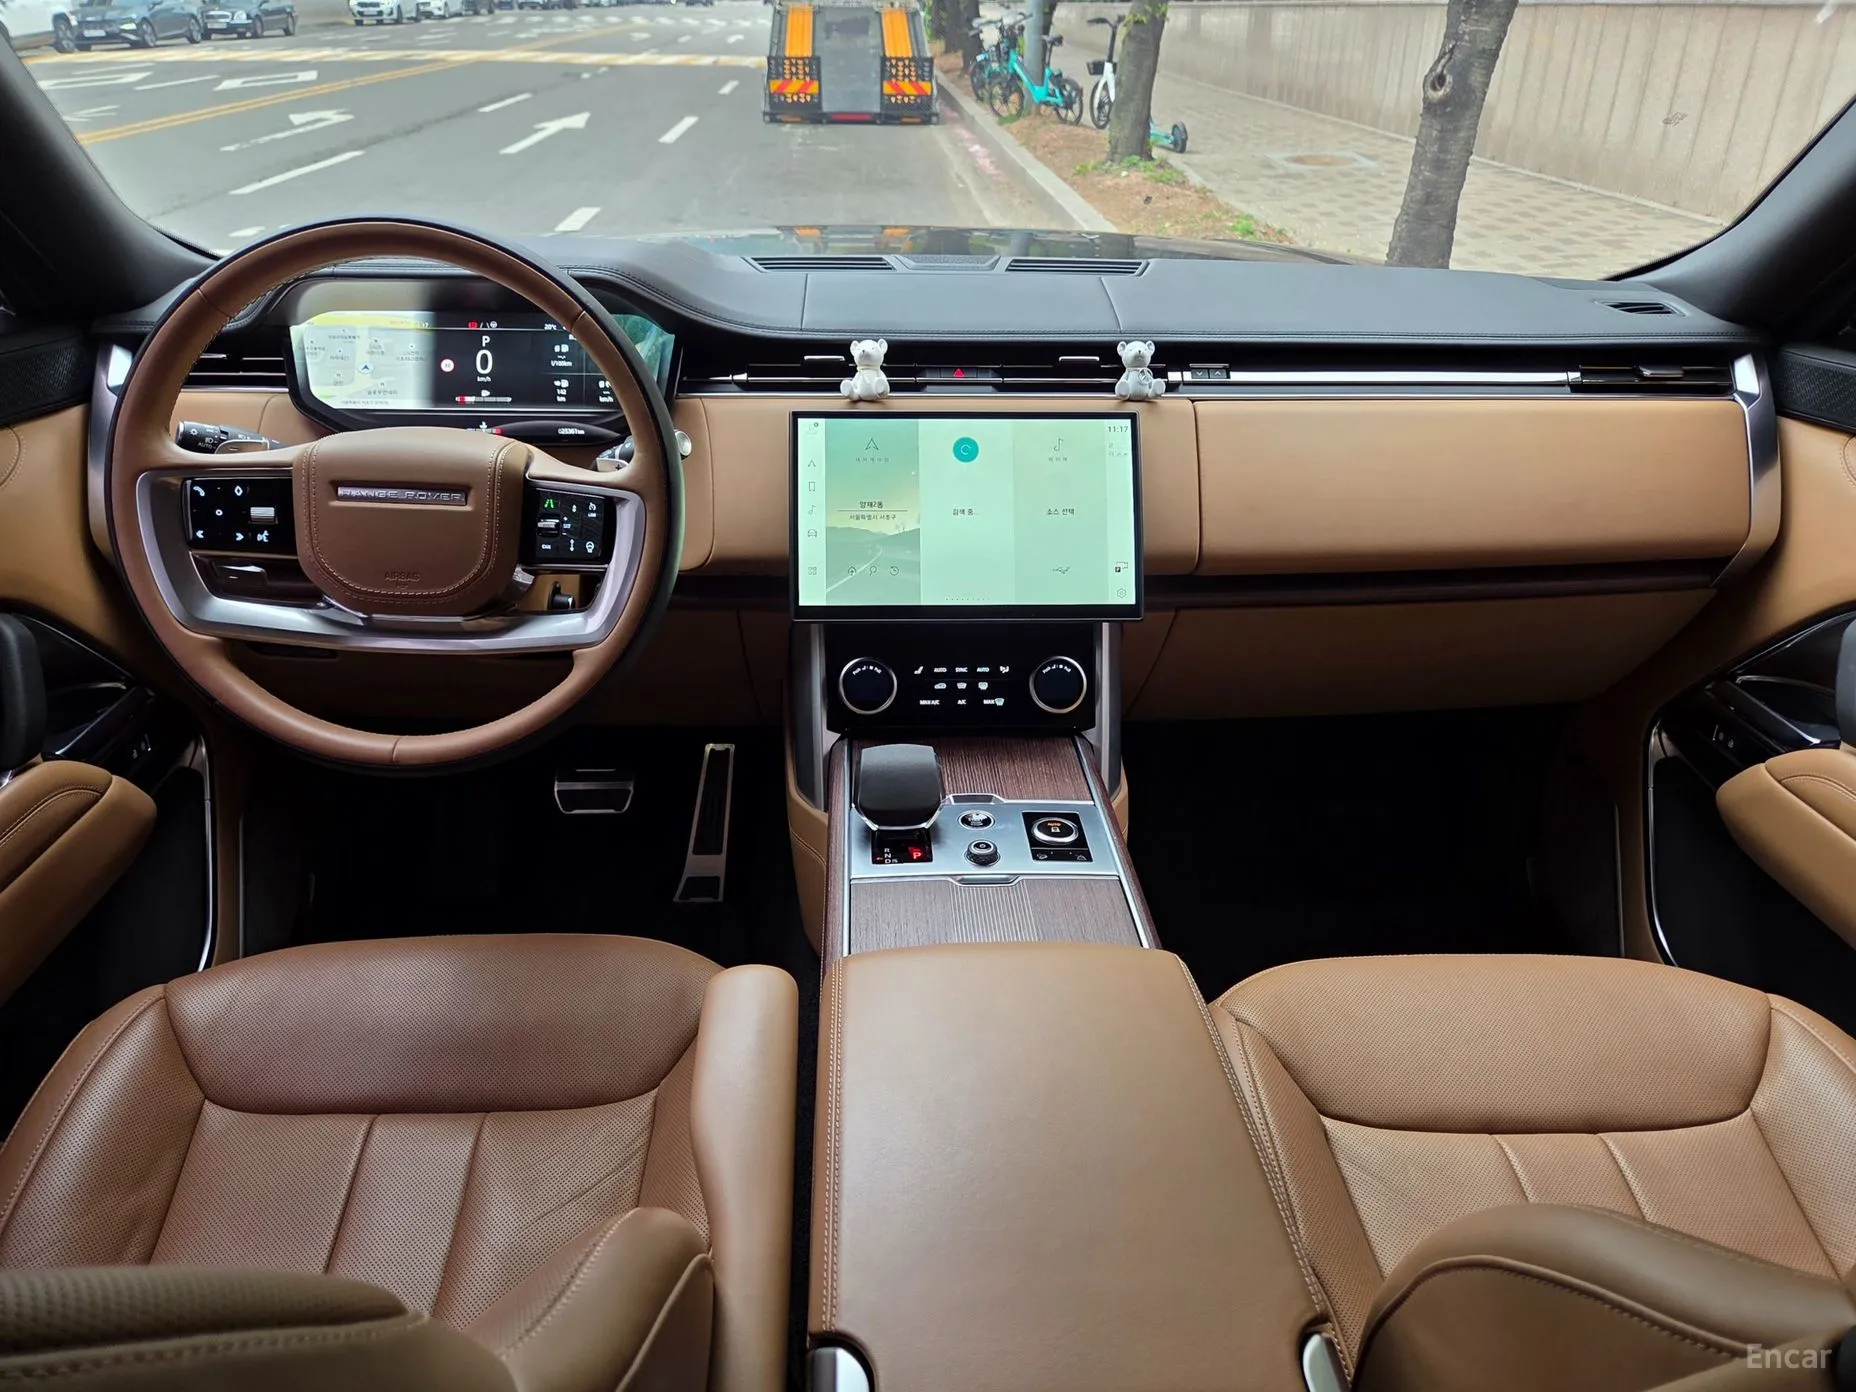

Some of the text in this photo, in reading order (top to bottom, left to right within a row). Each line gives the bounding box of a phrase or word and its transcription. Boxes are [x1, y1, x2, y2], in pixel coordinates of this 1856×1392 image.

[482, 335, 490, 347] P
[475, 349, 493, 374] 0
[341, 489, 461, 500] RANGE ROVER
[1061, 508, 1075, 516] 선택
[384, 571, 420, 581] AIRBAG
